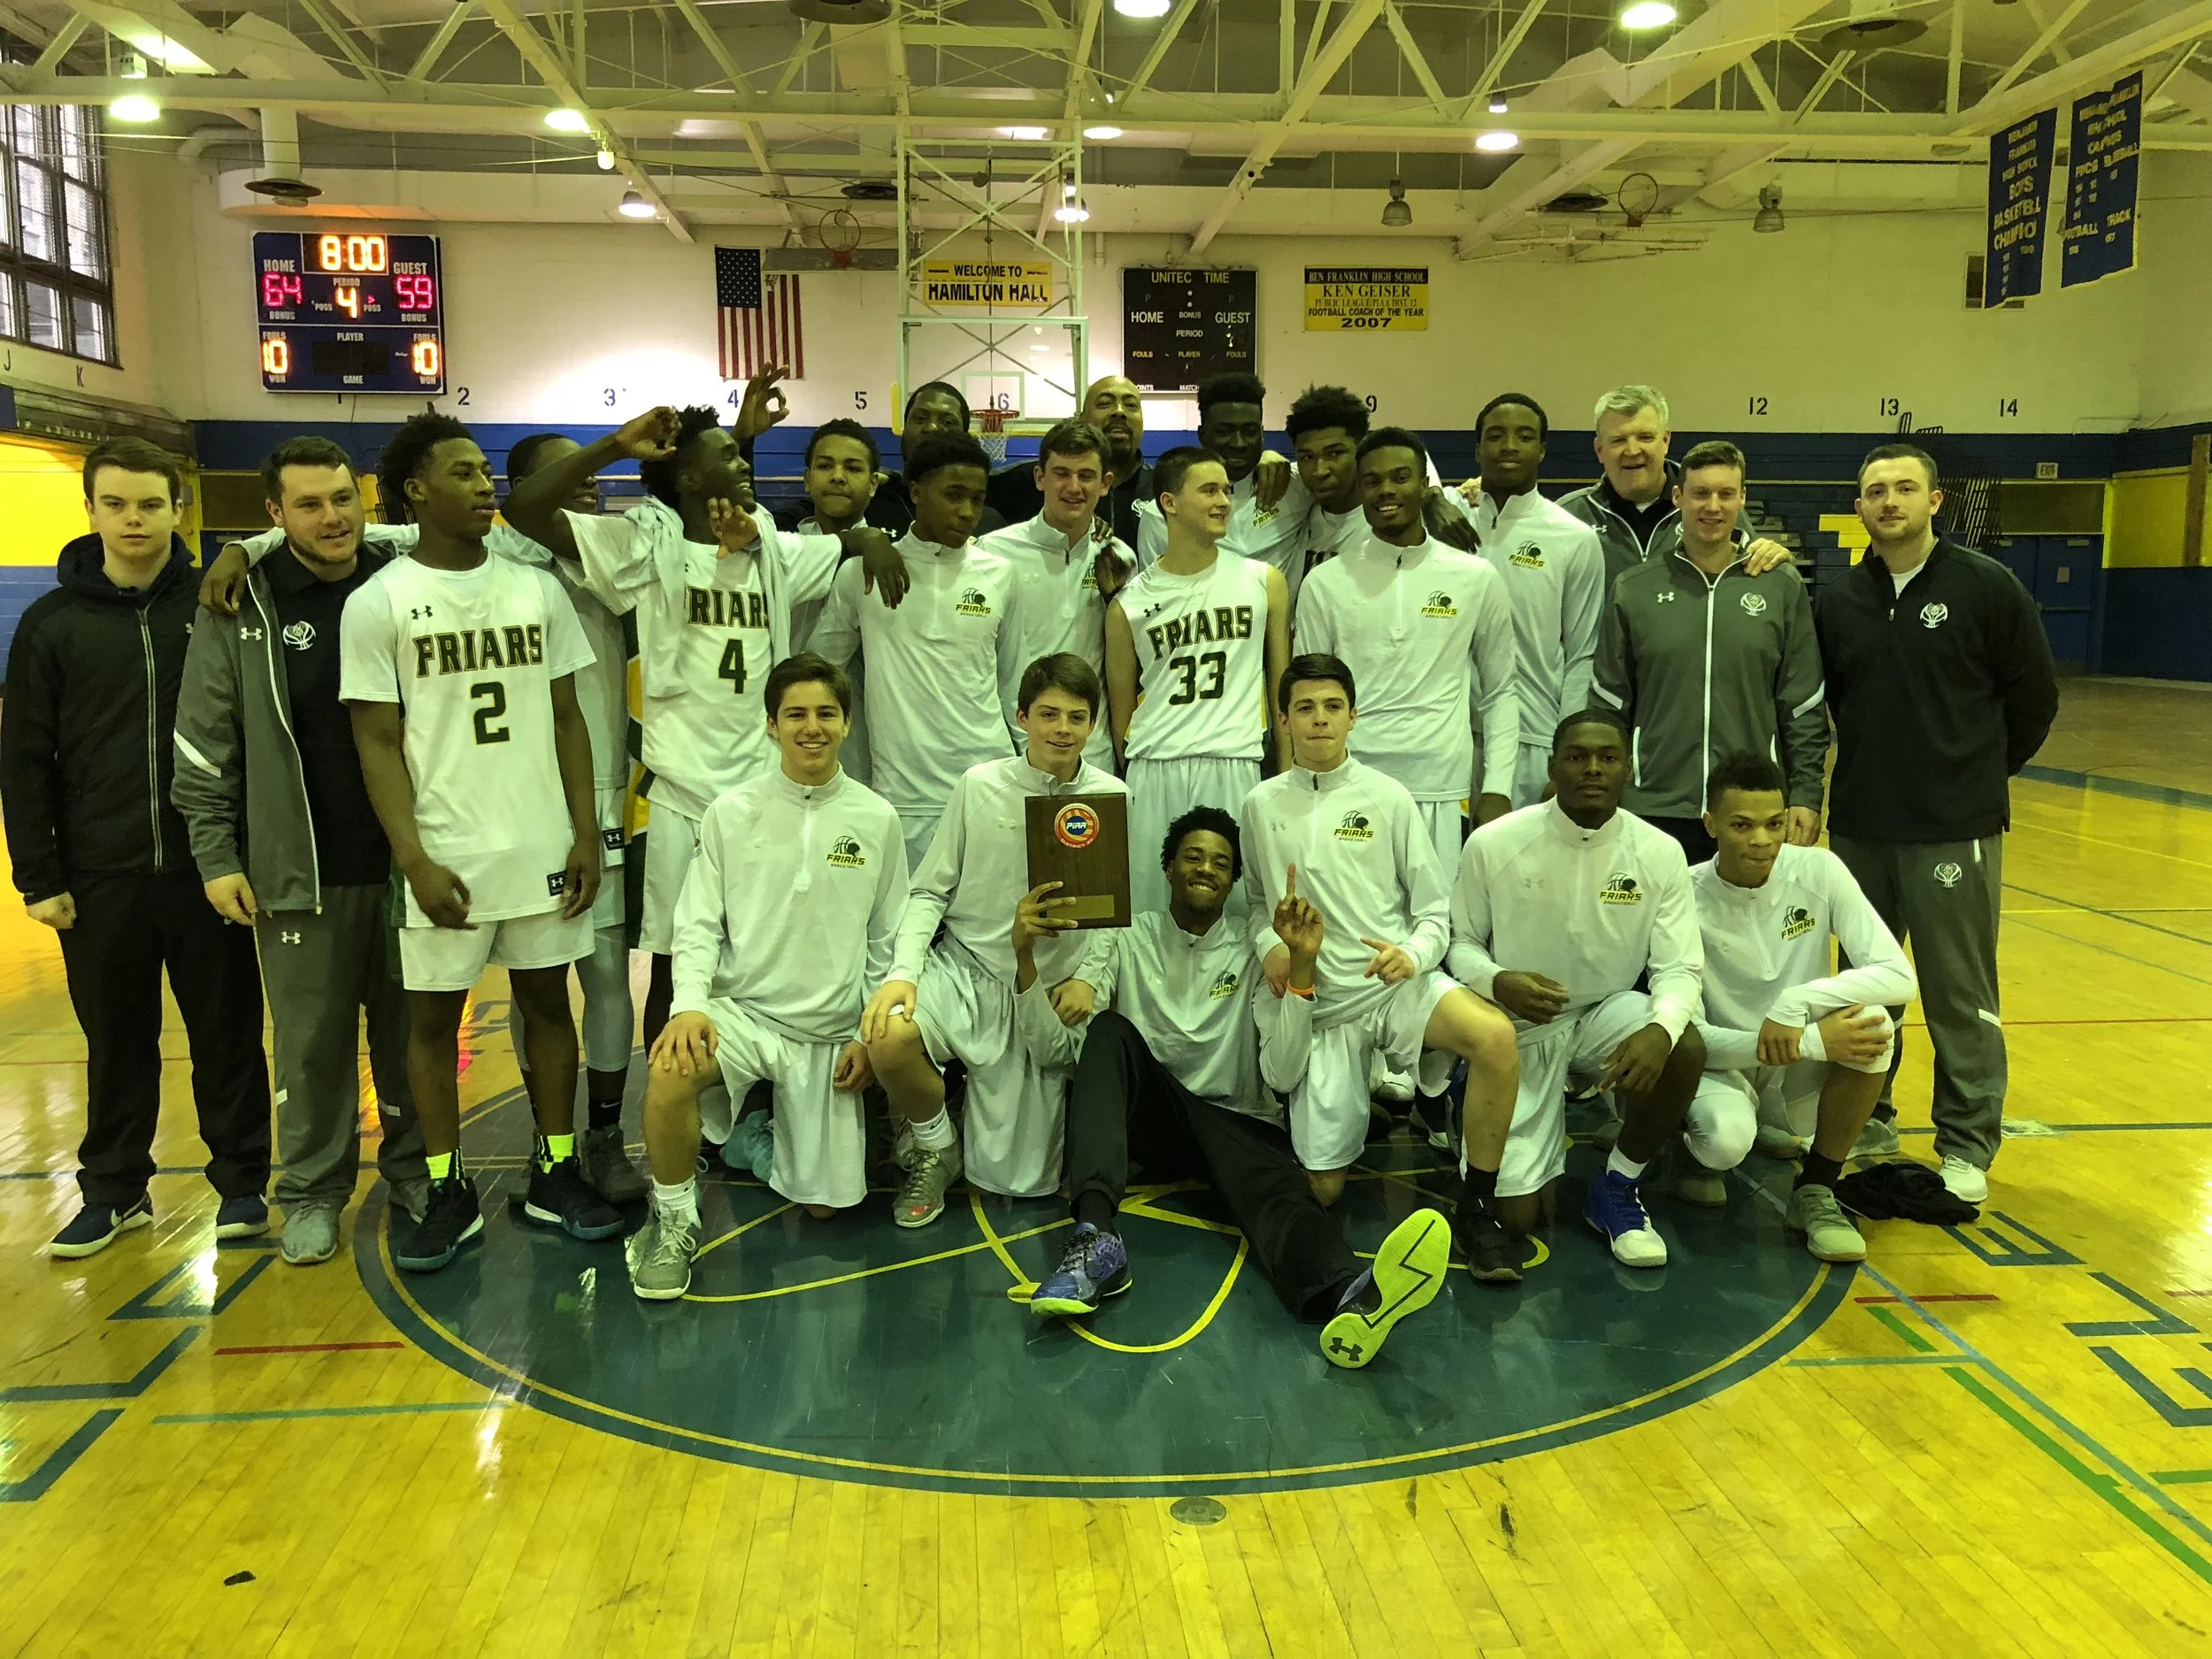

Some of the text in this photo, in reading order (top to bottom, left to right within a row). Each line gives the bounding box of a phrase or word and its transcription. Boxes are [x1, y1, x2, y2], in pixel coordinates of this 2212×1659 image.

[320, 234, 385, 271] 8:00
[264, 259, 296, 273] HOME
[393, 262, 427, 275] GUEST
[954, 265, 1022, 278] WELCOME TO
[333, 278, 360, 287] PERIOD
[1203, 273, 1230, 283] TIME
[1310, 272, 1425, 282] BEN FRANKLIN HIGH SCHOOL
[265, 273, 303, 307] 64
[396, 276, 433, 310] 59
[929, 283, 1048, 303] HAMILTON HALL
[1322, 285, 1410, 297] KEN GEISER
[336, 287, 357, 319] 4
[269, 311, 296, 320] BONUS
[402, 313, 426, 322] BONUS
[1131, 311, 1164, 323] HOME
[1215, 311, 1251, 324] GUEST
[1309, 308, 1347, 317] FOOTBALL
[1348, 308, 1373, 317] COACH
[1404, 308, 1424, 317] YEAR
[1341, 318, 1393, 327] 2007
[336, 333, 364, 342] PLAYER
[1176, 329, 1203, 338] PERIOD
[4, 349, 11, 372] J
[76, 365, 84, 388] K
[343, 375, 364, 384] GAME
[457, 387, 471, 405] 2
[603, 388, 616, 407] 3
[727, 389, 739, 409] 4
[855, 391, 867, 411] 5
[998, 393, 1009, 411] 6
[1365, 395, 1377, 412] 9
[1749, 397, 1768, 415] 12
[1881, 398, 1899, 416] 13
[2000, 398, 2017, 417] 14
[1509, 554, 1545, 567] FRIARS
[684, 585, 770, 629] RIAR
[956, 603, 992, 614] FRIARS
[1421, 607, 1457, 616] FRIARS
[1146, 605, 1253, 662] FRIARS
[412, 624, 543, 679] FRIARS
[718, 638, 748, 695] 4
[1169, 651, 1226, 705] 33
[470, 681, 511, 746] 2
[1334, 828, 1373, 838] FRIARS
[826, 854, 866, 865] FRIARS
[1600, 892, 1642, 901] FRIARS
[1781, 918, 1816, 940] FRIARS
